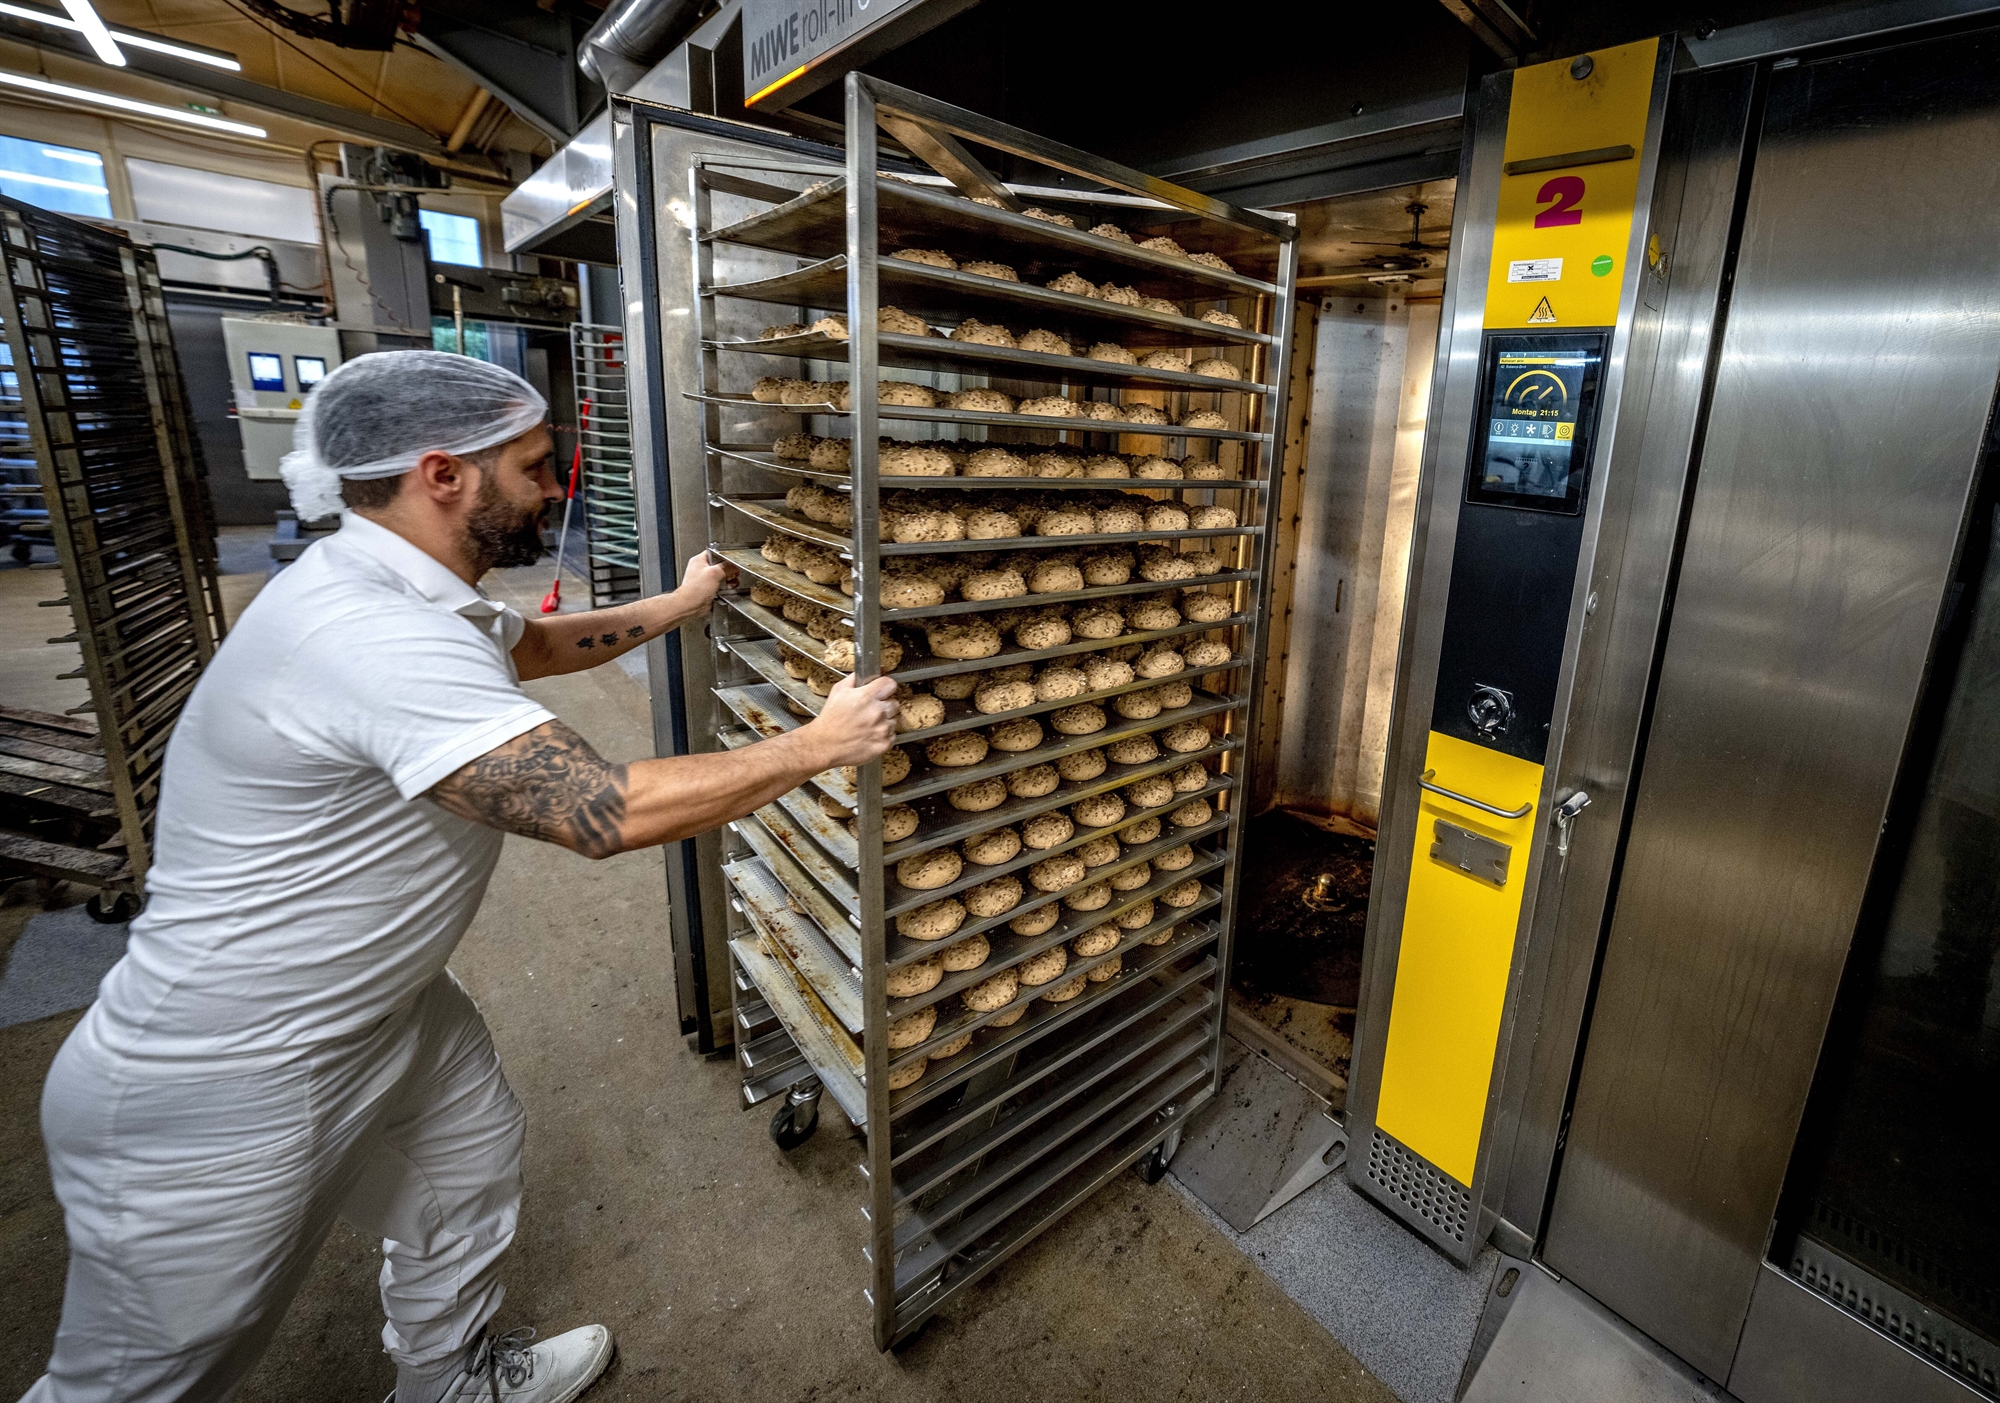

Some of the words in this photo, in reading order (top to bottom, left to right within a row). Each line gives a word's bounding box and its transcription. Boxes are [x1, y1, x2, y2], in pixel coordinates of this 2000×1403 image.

[751, 12, 800, 81] MIWE
[1534, 175, 1586, 229] 2
[1511, 408, 1537, 417] Montag
[1540, 409, 1559, 417] 21:15
